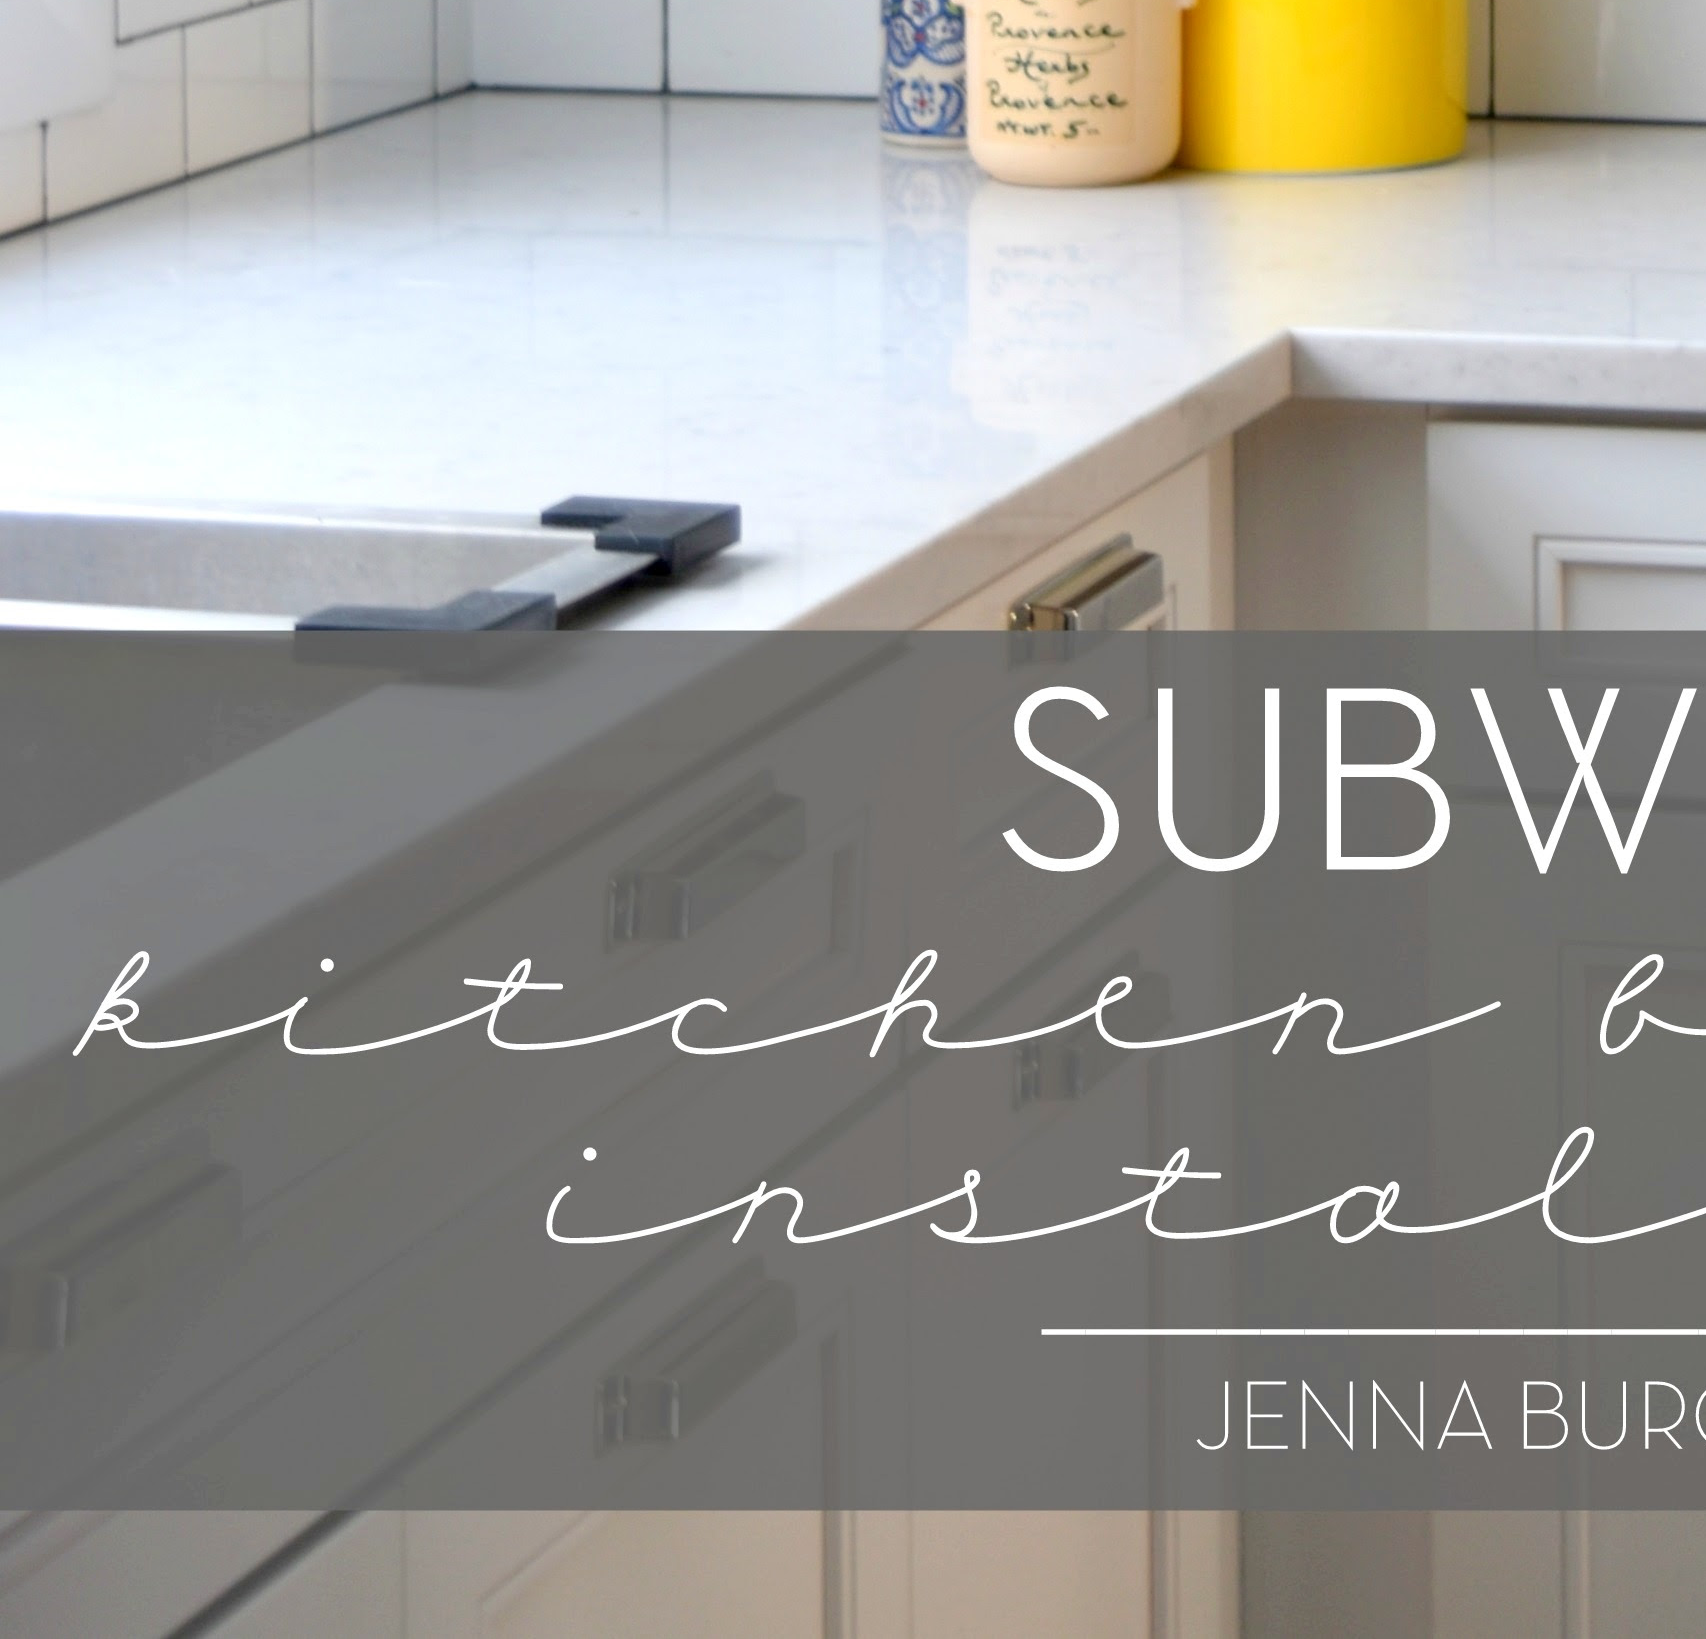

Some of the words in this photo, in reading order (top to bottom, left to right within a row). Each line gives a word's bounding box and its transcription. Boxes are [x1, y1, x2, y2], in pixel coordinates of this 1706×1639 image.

[986, 12, 1126, 39] Provence
[1004, 50, 1090, 84] Herbs
[986, 79, 1128, 110] Provence
